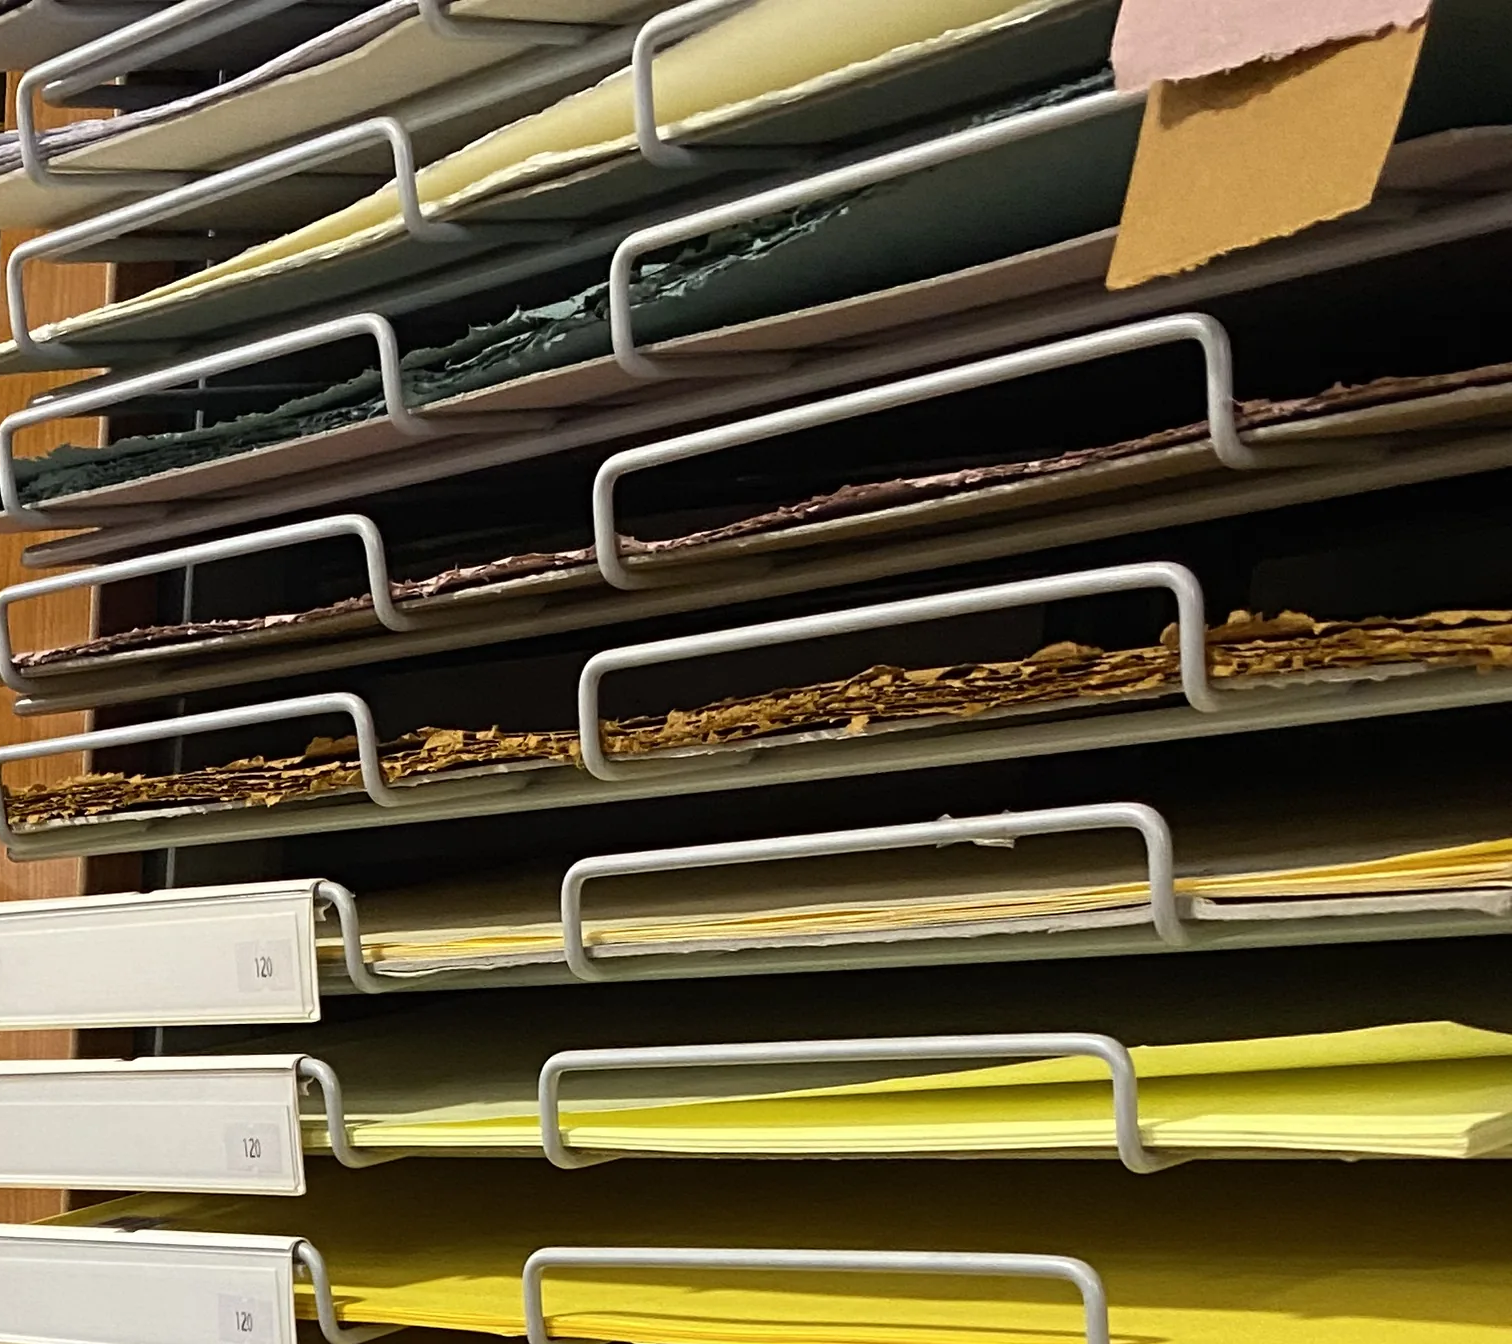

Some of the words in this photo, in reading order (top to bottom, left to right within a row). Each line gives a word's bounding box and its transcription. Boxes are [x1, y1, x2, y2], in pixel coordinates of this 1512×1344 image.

[254, 956, 273, 979] 120
[242, 1137, 262, 1159] 120
[235, 1311, 253, 1333] 120
